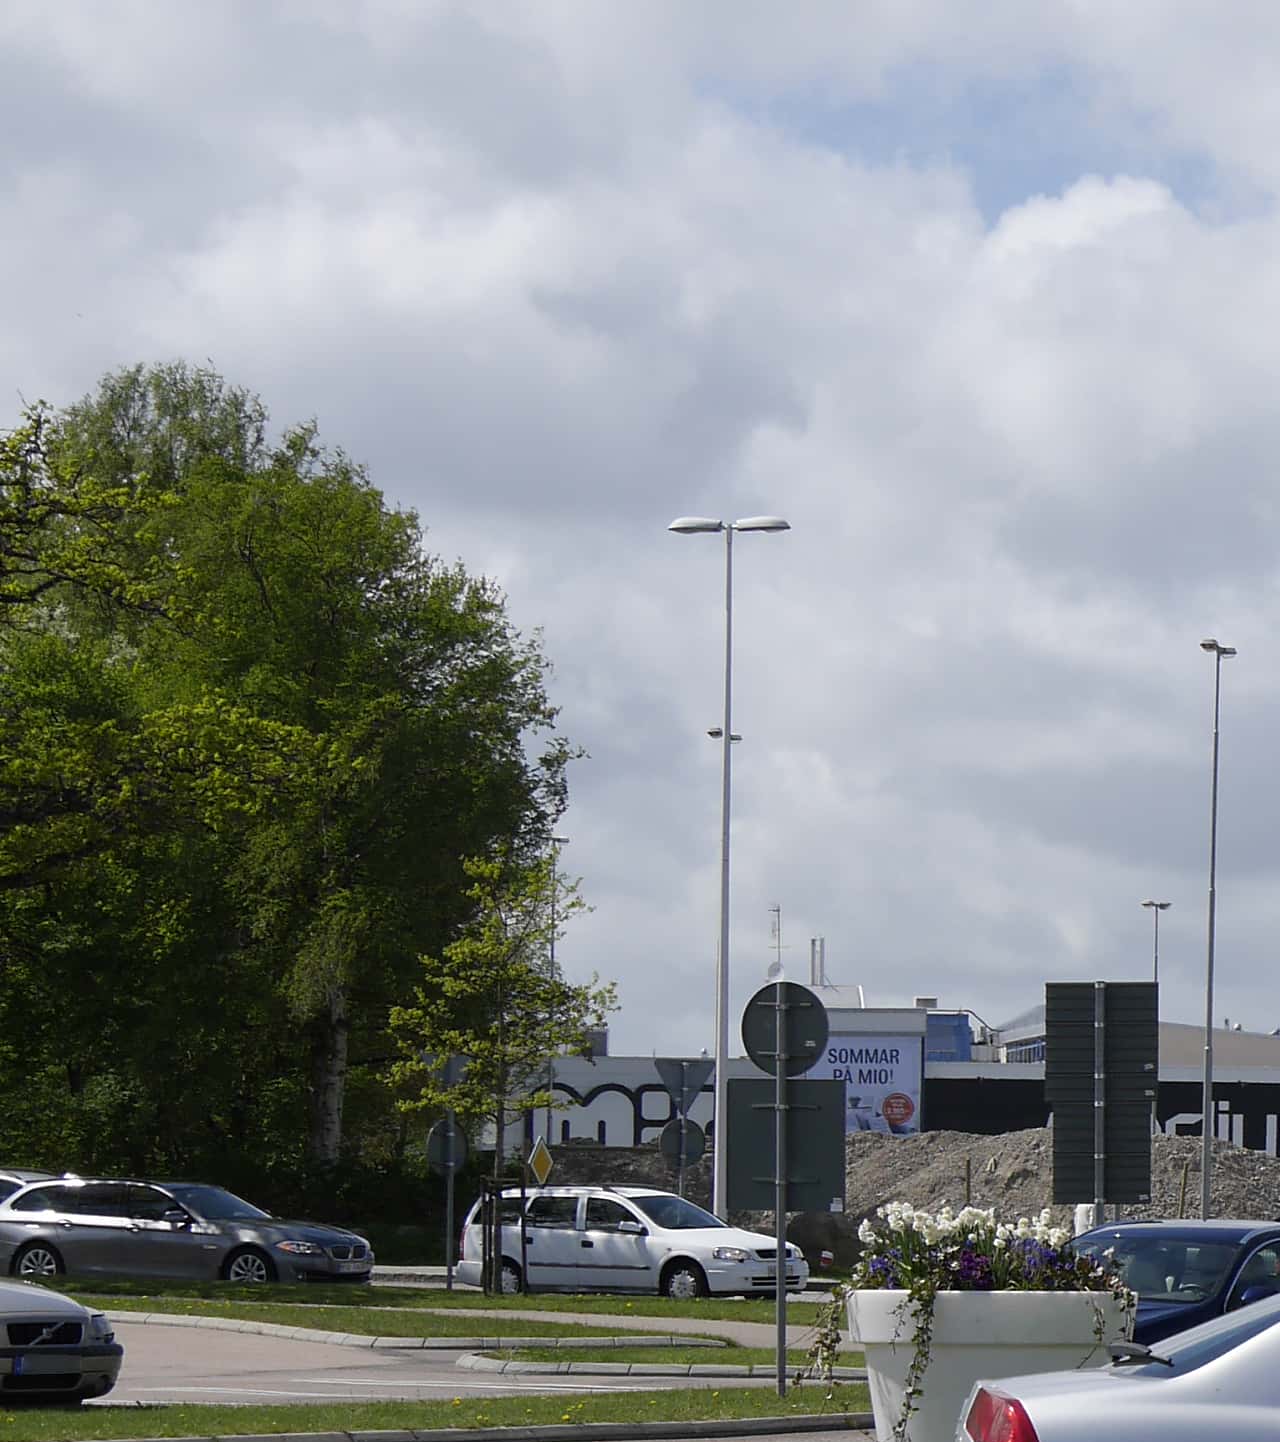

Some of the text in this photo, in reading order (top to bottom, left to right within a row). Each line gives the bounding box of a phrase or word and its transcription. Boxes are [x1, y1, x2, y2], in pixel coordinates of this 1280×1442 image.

[828, 1048, 900, 1065] SOMMAR
[833, 1064, 895, 1084] PÅ MIO!
